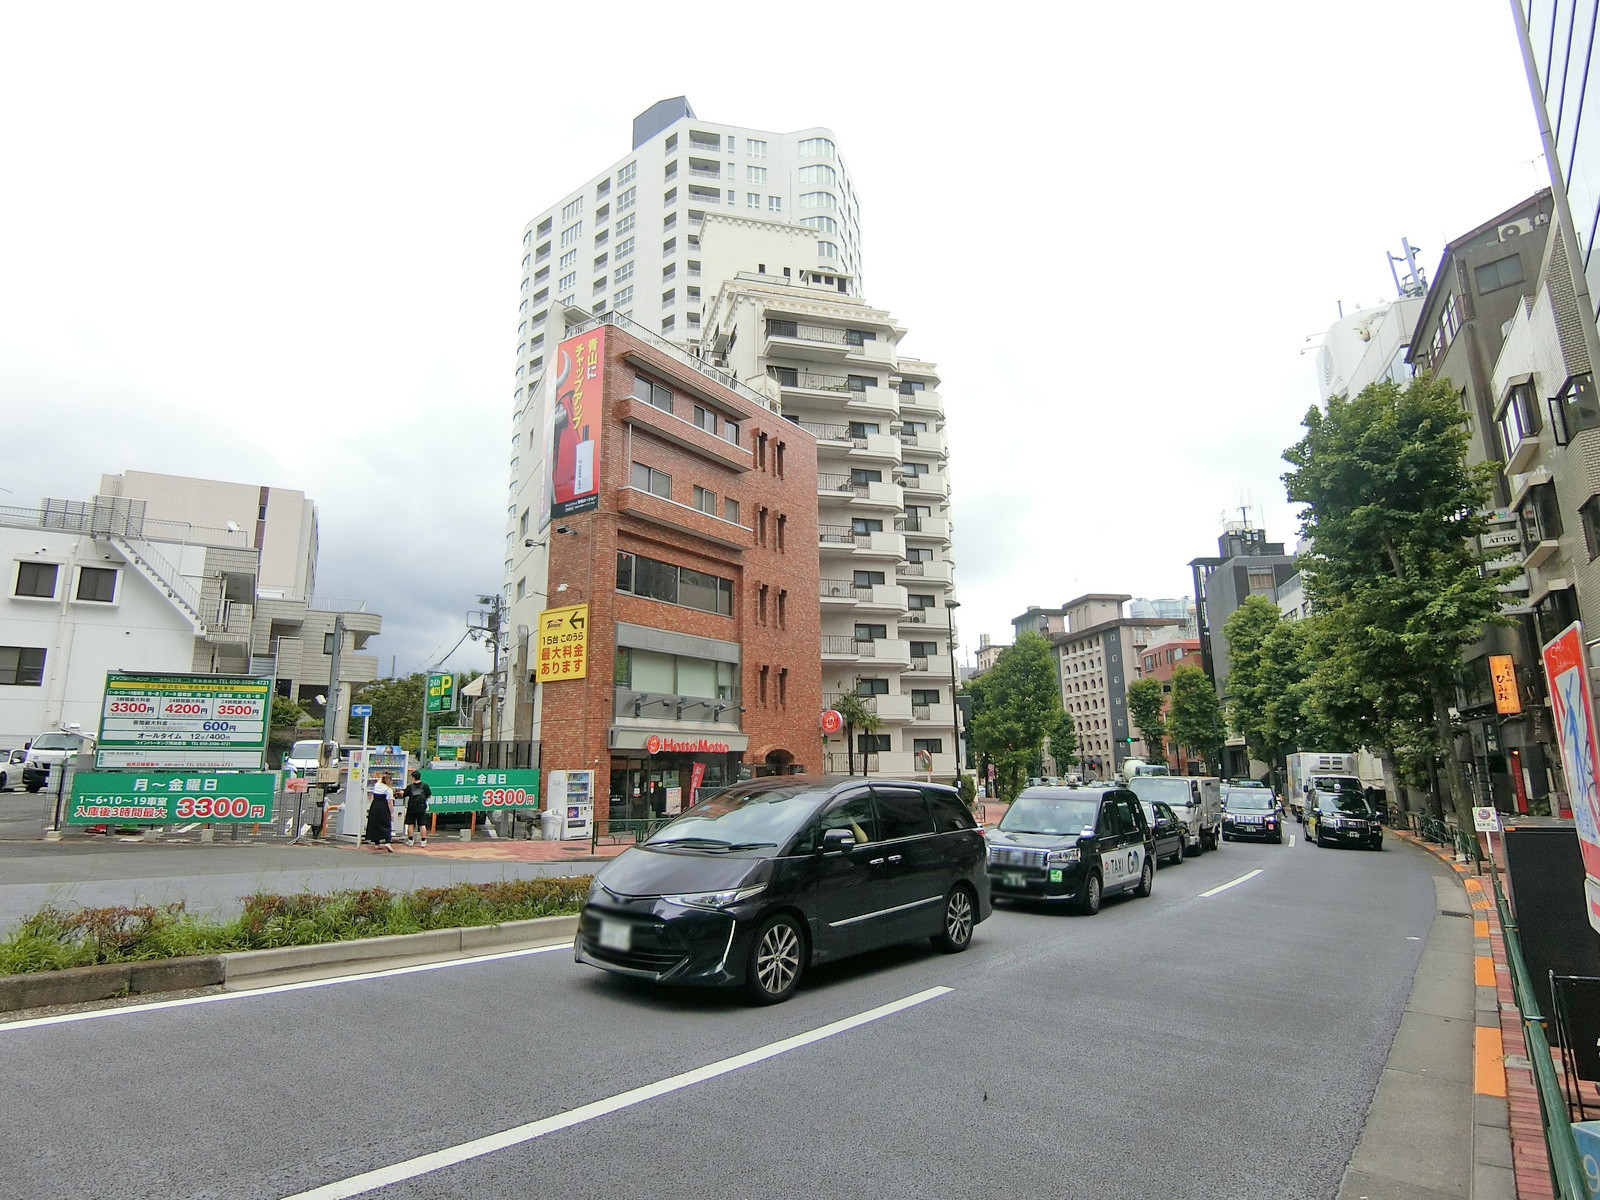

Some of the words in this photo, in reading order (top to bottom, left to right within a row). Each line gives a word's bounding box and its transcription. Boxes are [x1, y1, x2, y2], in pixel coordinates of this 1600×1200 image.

[587, 338, 598, 380] 青山に
[572, 343, 585, 430] チャップアップ
[1489, 536, 1517, 544] ATTIC
[542, 635, 559, 645] 15台
[560, 632, 584, 643] このうら
[541, 644, 584, 661] 最大料金
[541, 659, 583, 675] あります
[430, 679, 440, 687] 24h
[441, 675, 452, 696] P
[110, 702, 155, 714] 3300円
[164, 704, 208, 715] 4200円
[217, 705, 259, 716] 3500円
[202, 721, 237, 732] 600円
[137, 732, 182, 740] オールタイム
[133, 778, 218, 792] 月～金曜日
[455, 774, 507, 785] 月～金曜日
[427, 795, 479, 805] 庫後3時間最大
[482, 788, 535, 807] 3300円
[74, 806, 168, 819] 入庫後3時間最大
[176, 796, 266, 818] 3300円
[1110, 858, 1124, 874] TAXI
[1127, 850, 1140, 875] GO
